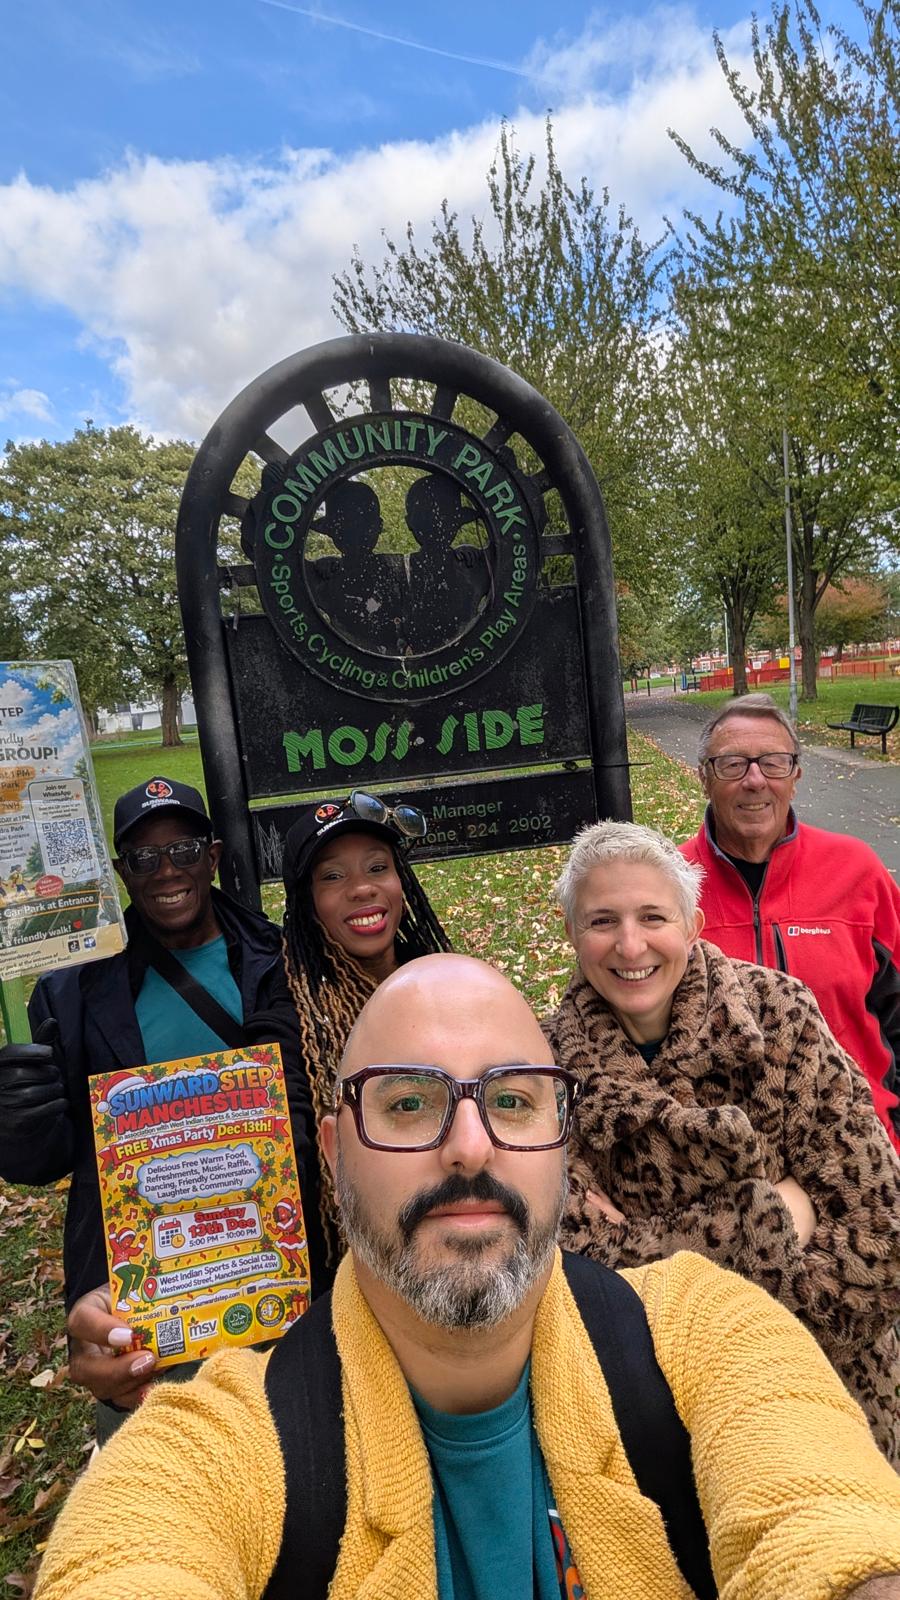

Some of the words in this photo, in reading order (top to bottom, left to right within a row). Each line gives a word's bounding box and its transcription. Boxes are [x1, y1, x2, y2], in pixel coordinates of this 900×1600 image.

[264, 420, 448, 550] COMMUNITY
[452, 443, 527, 535] PARK
[307, 633, 375, 689] Cycling
[377, 672, 388, 687] &
[392, 648, 485, 688] Children's
[480, 611, 518, 650] Play
[504, 544, 526, 607] Areas
[0, 707, 24, 718] TEP
[282, 721, 412, 773] MOSS
[435, 704, 546, 755] SIDE
[432, 801, 503, 820] Manager
[467, 823, 497, 839] 224
[510, 815, 552, 833] 2902
[24, 901, 46, 914] Park
[47, 901, 57, 910] at
[58, 895, 94, 908] Entrance
[14, 931, 47, 946] friendly
[48, 925, 72, 937] walk!
[110, 1074, 219, 1117] SUNWARD
[220, 1067, 273, 1092] STEP
[115, 1087, 270, 1135] MANCHESTER
[205, 1114, 224, 1124] Sports
[116, 1139, 149, 1159] FREE
[150, 1134, 182, 1149] Xmas
[183, 1127, 215, 1142] Party
[217, 1124, 240, 1136] Dec
[242, 1119, 272, 1133] 13th!
[146, 1168, 200, 1183] Refreshments,
[202, 1163, 226, 1174] Music,
[227, 1159, 251, 1169] Raffle,
[147, 1164, 180, 1175] Delicious
[182, 1159, 199, 1169] Free
[200, 1155, 224, 1165] Warm
[225, 1150, 247, 1160] Food,
[145, 1181, 177, 1192] Dancing,
[178, 1175, 208, 1186] Friendly
[209, 1168, 256, 1181] Conversation,
[157, 1186, 190, 1199] Laughter
[200, 1178, 243, 1191] Community
[194, 1207, 247, 1223] Sunday
[188, 1221, 224, 1238] 13th
[226, 1218, 256, 1231] Dec
[189, 1237, 205, 1247] 5:00
[207, 1235, 219, 1243] PM
[226, 1230, 245, 1239] 10:00
[246, 1228, 257, 1236] PM
[160, 1275, 179, 1286] West
[180, 1268, 202, 1280] Indian
[204, 1262, 229, 1275] Sports
[231, 1260, 238, 1268] &
[239, 1254, 260, 1266] Social
[261, 1253, 276, 1261] Club
[160, 1282, 192, 1294] Westwood
[193, 1276, 214, 1287] Street,
[214, 1267, 250, 1281] Manchester
[251, 1263, 263, 1271] M14
[189, 1320, 217, 1337] msv
